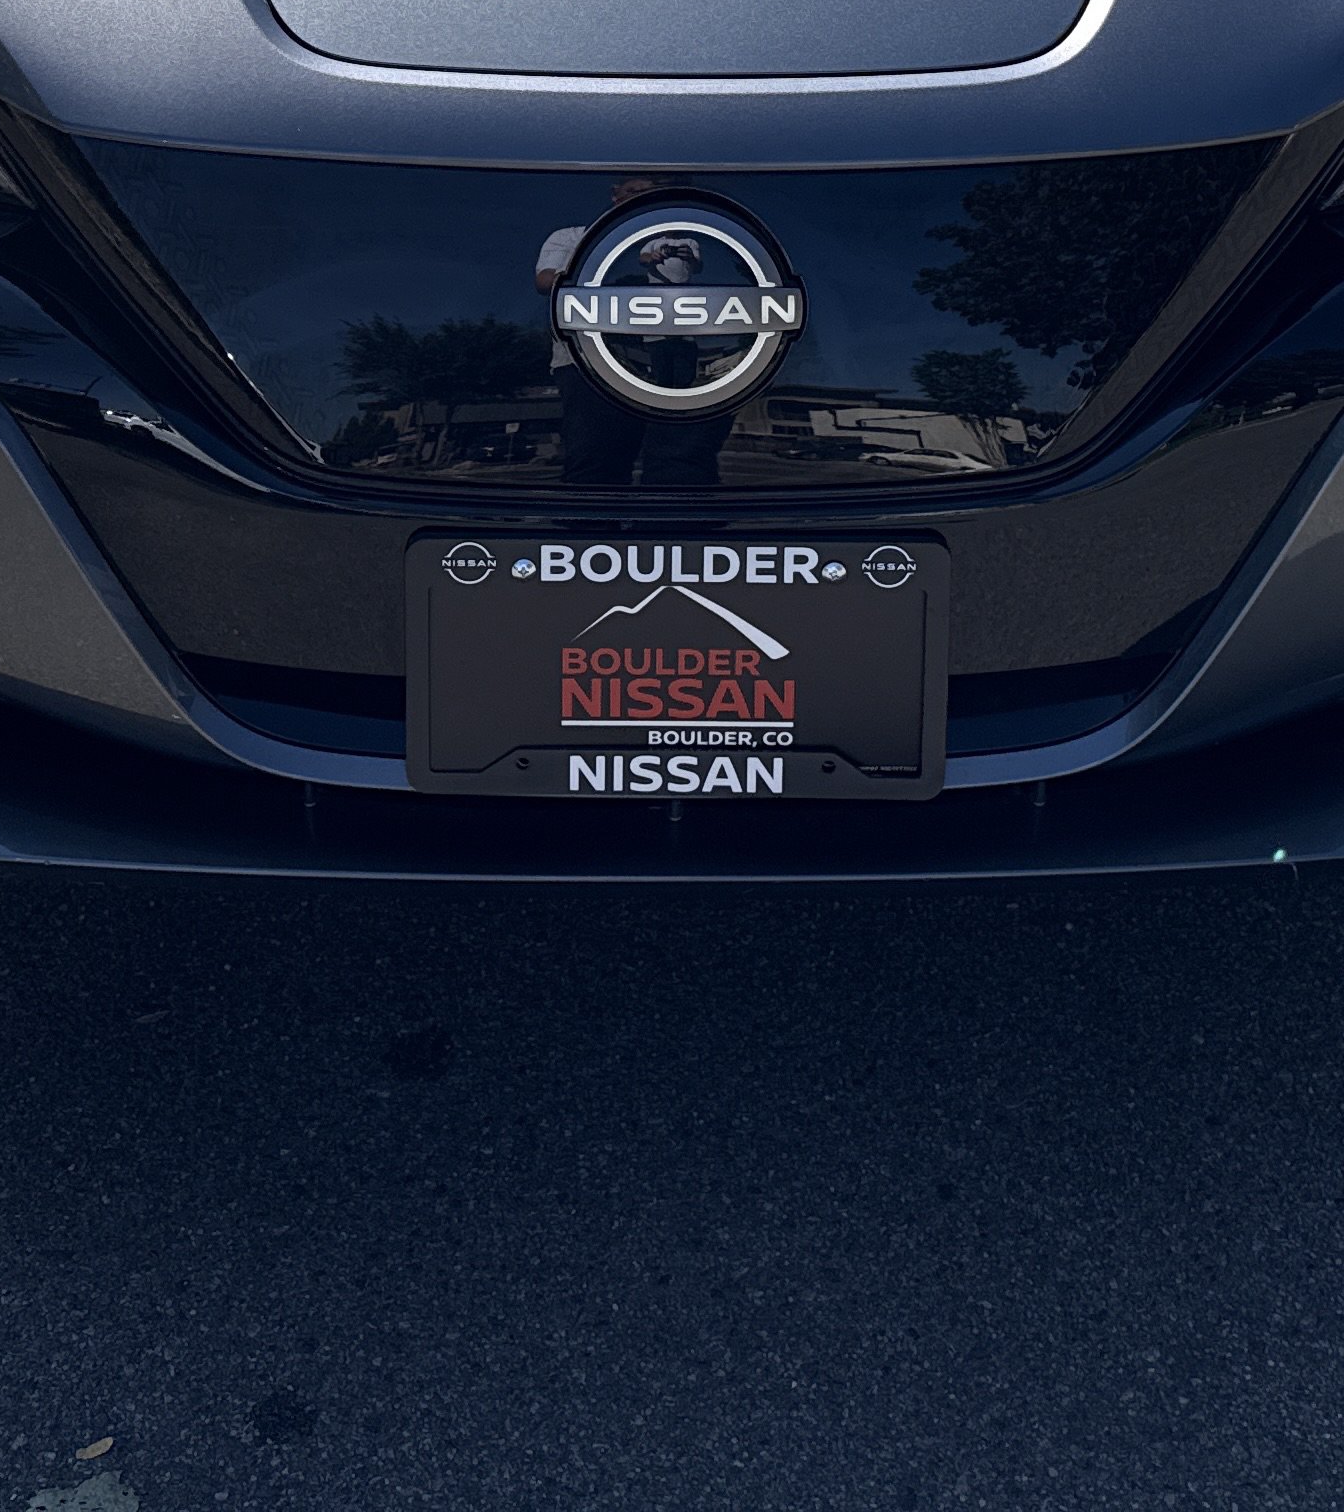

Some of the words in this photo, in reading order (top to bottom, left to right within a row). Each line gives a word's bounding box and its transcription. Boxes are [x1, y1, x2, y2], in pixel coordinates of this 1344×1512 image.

[564, 295, 795, 325] NISSAN
[441, 559, 497, 567] NISSAN
[541, 544, 819, 584] BOULDER
[861, 562, 917, 571] NISSAN
[561, 647, 761, 676] BOULDER
[561, 678, 795, 720] NISSAN
[648, 730, 757, 747] BOULDER,
[762, 731, 794, 746] CO
[569, 755, 784, 793] NISSAN
